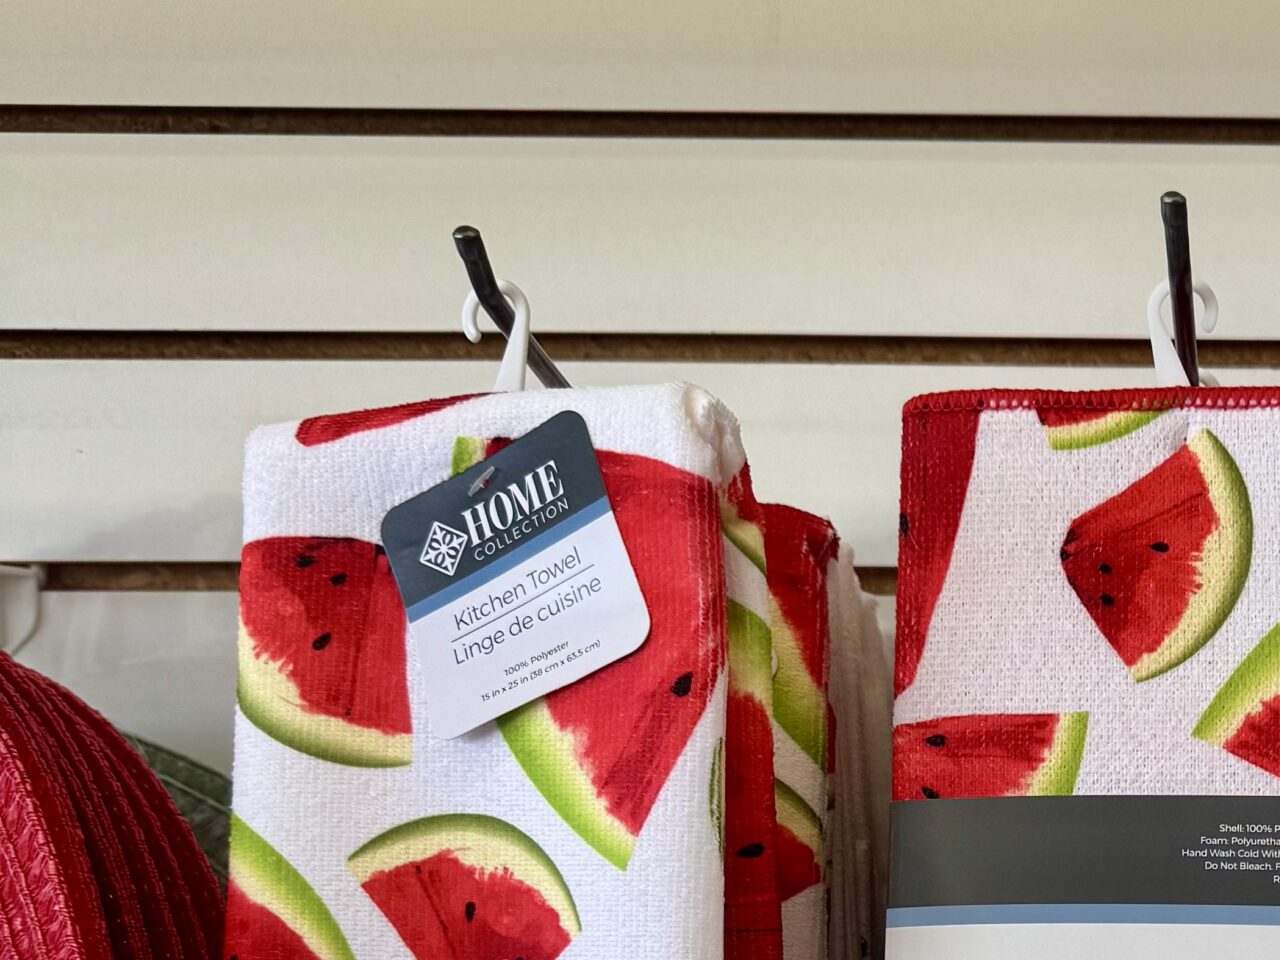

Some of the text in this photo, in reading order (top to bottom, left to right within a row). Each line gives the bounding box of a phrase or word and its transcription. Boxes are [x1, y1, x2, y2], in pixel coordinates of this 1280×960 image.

[461, 459, 565, 548] HOME
[474, 498, 570, 561] COLLECTION
[453, 546, 582, 631] Kitchen Towel
[453, 576, 602, 665] Linge de cuisine
[481, 692, 491, 702] 15
[491, 689, 501, 698] in
[507, 679, 520, 690] 25
[520, 675, 529, 684] in
[530, 668, 544, 681] (38
[544, 662, 560, 673] cm
[566, 648, 584, 663] 63.5
[584, 639, 602, 654] cm)
[504, 641, 570, 676] 100% Polyester
[1181, 848, 1208, 858] Hand
[1209, 849, 1236, 858] Wash
[1237, 849, 1260, 858] Cold
[1245, 824, 1273, 833] 100%
[1204, 861, 1219, 870] Do
[1220, 861, 1238, 870] Not
